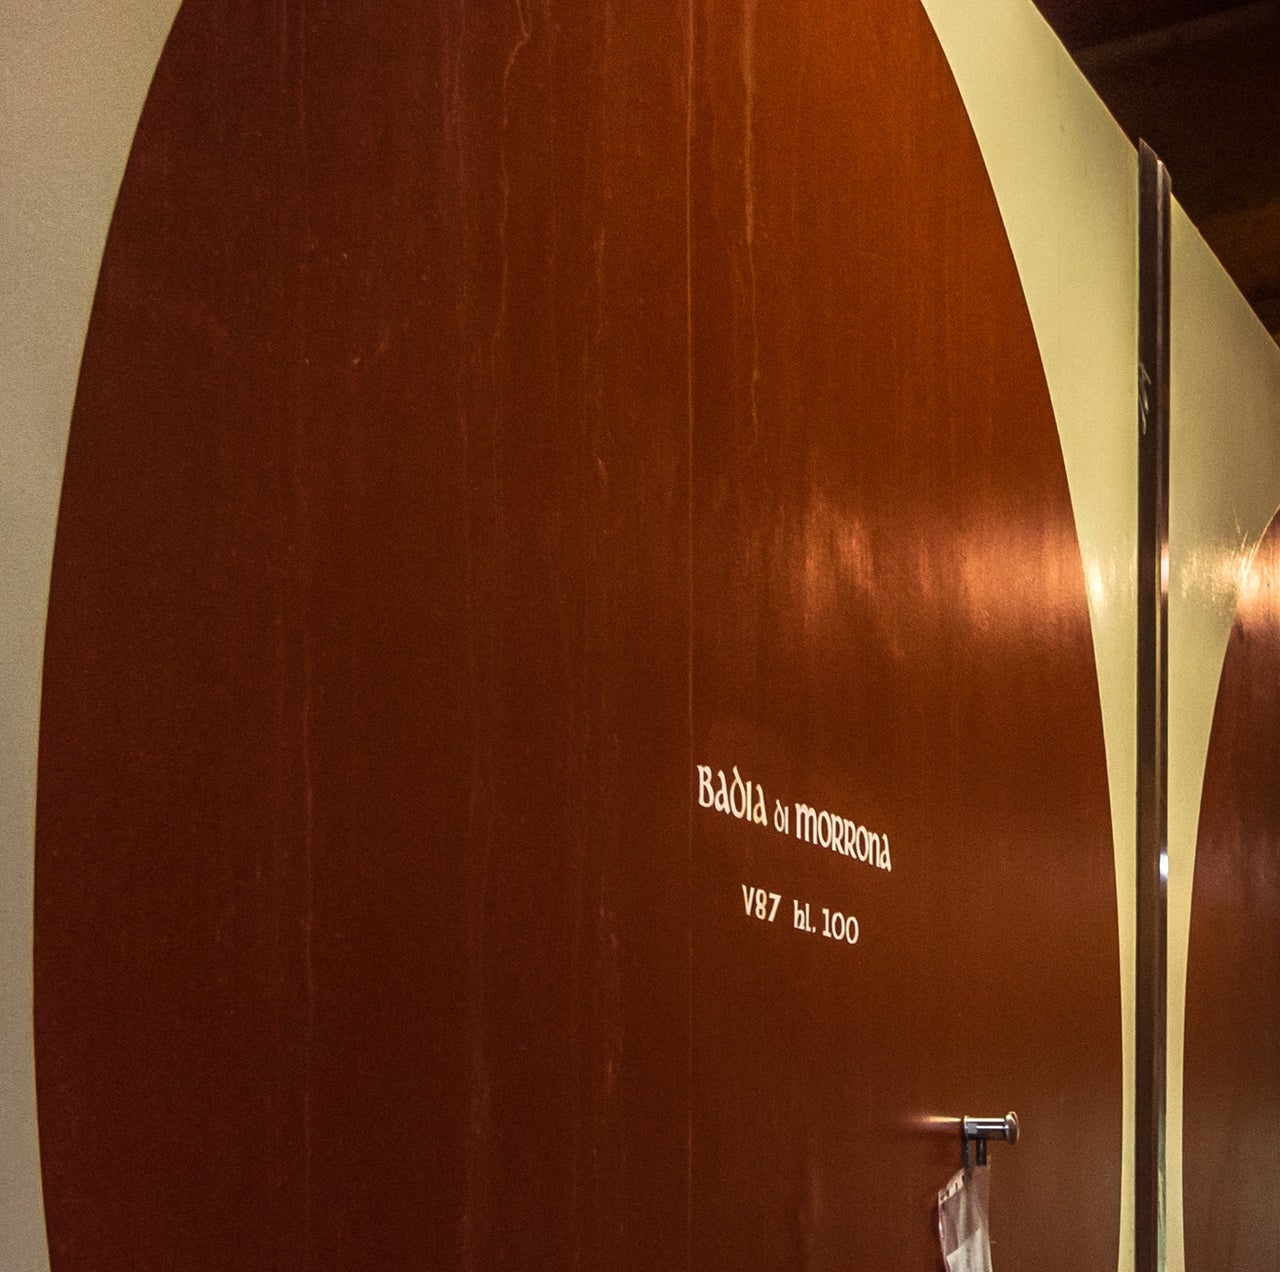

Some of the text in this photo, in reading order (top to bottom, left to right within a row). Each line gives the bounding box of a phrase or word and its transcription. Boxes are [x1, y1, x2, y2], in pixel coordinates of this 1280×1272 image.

[697, 765, 892, 871] Badia di Morrona
[741, 884, 781, 923] V87
[822, 908, 859, 944] 100
